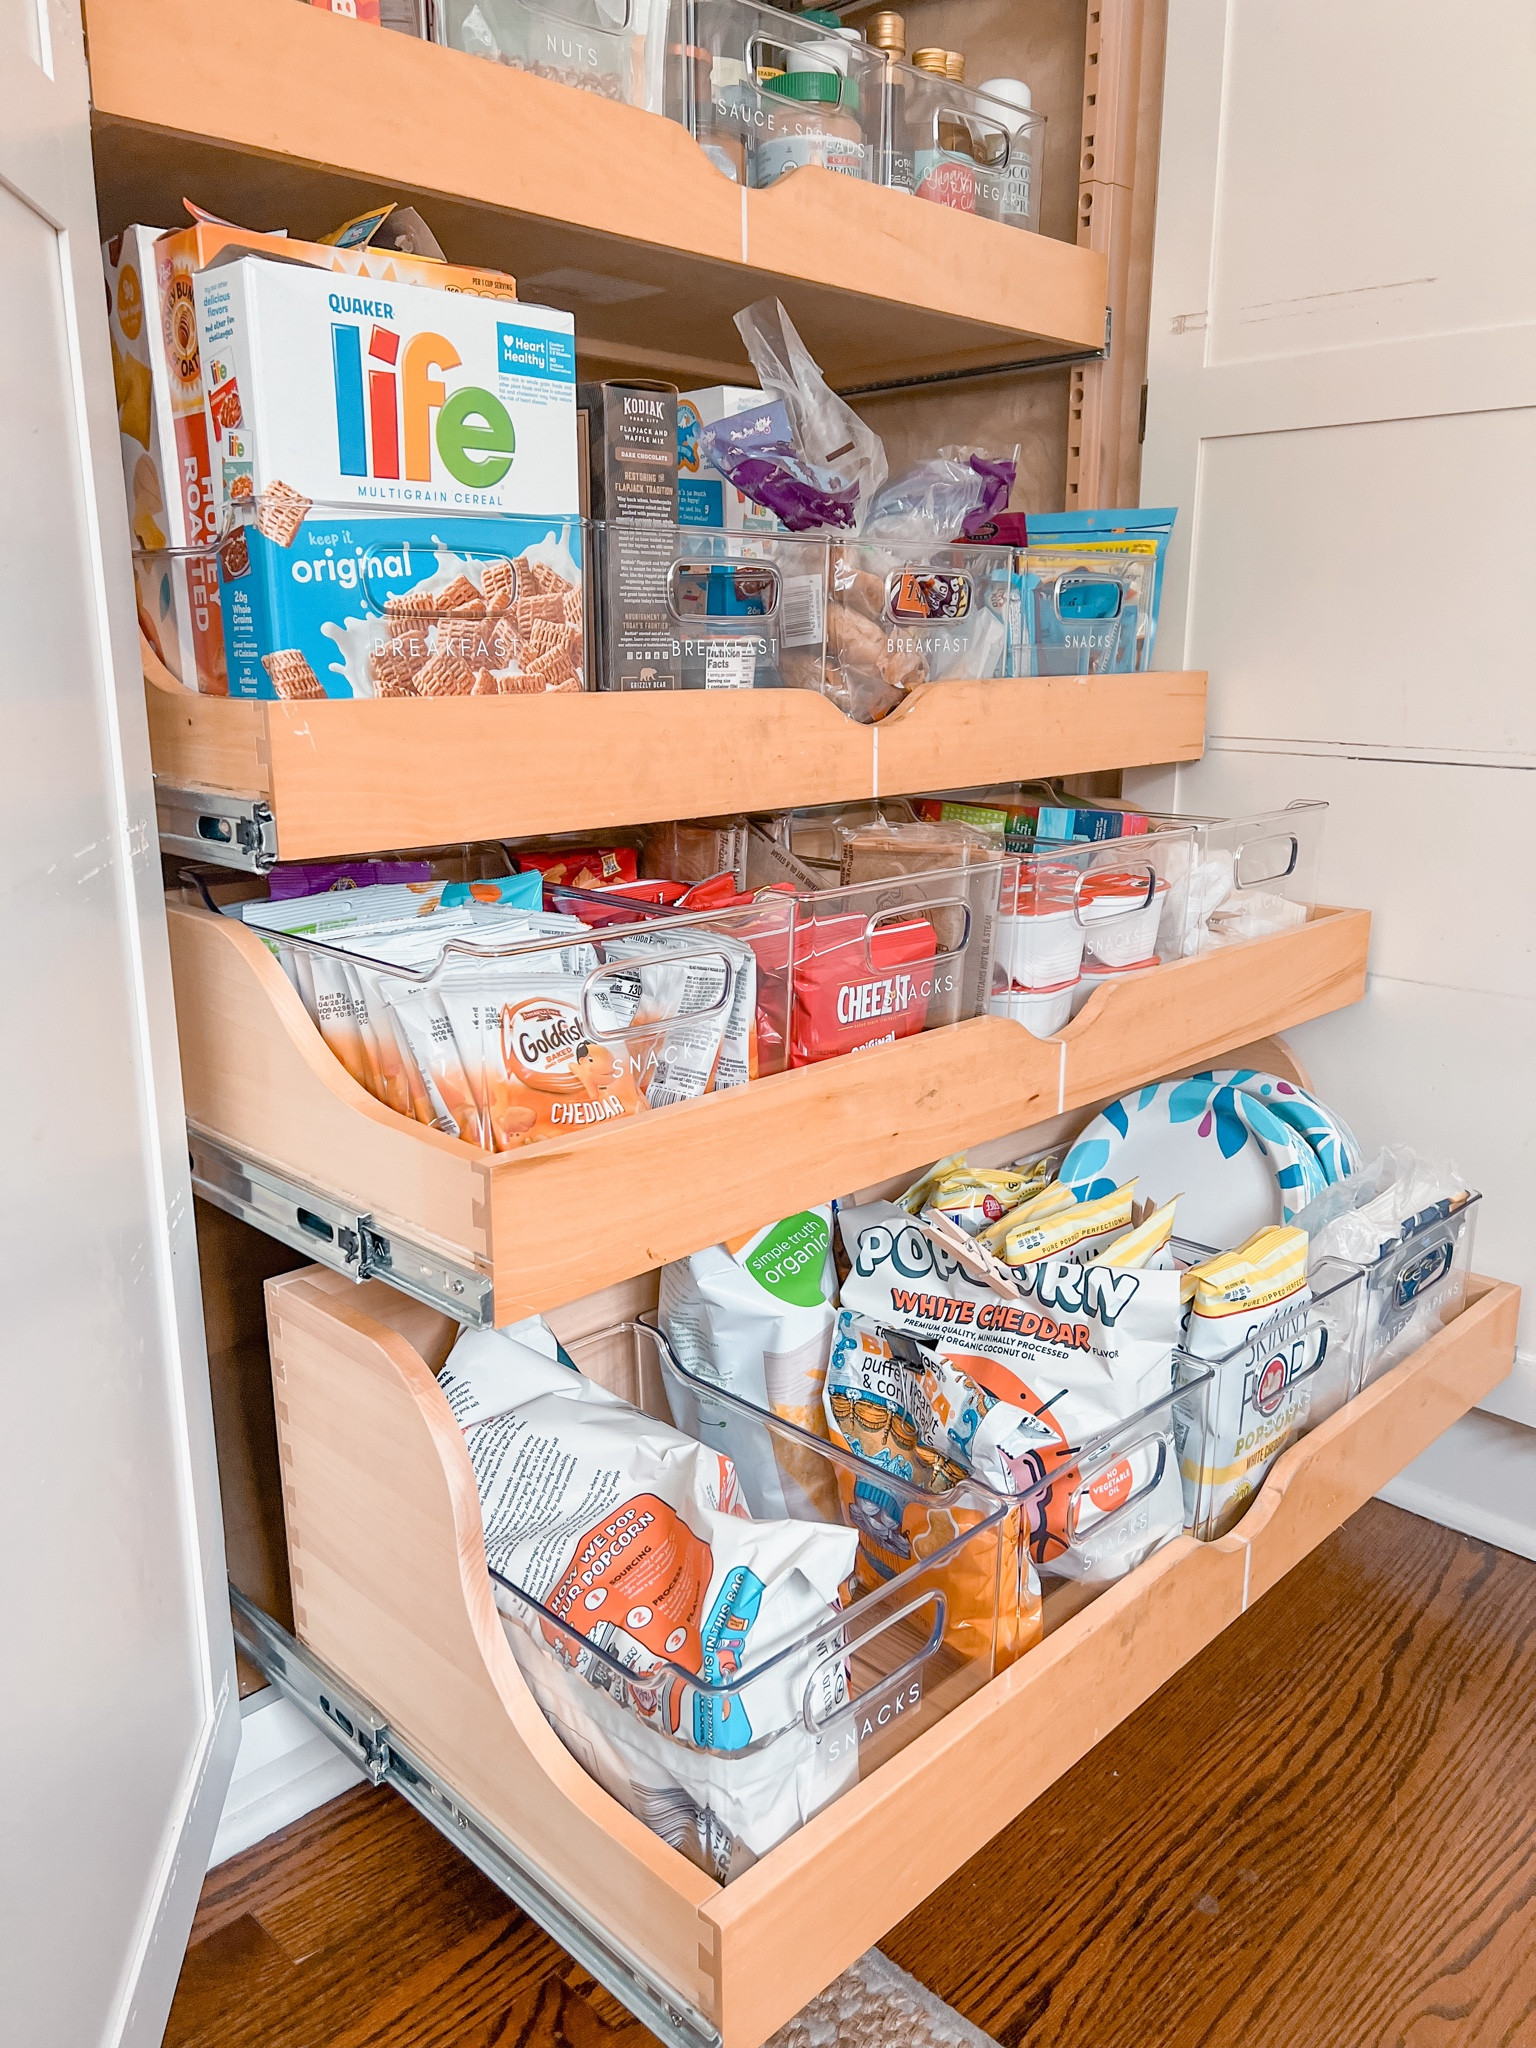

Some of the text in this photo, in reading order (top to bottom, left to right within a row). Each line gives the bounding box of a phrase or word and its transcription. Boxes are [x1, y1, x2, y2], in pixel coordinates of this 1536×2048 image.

[547, 33, 598, 66] NUTS
[718, 98, 775, 131] SAUCE
[795, 123, 865, 158] SPREADS
[204, 292, 230, 307] delicious
[328, 293, 394, 320] QUAKER
[207, 305, 229, 317] flavors
[516, 337, 545, 353] Heart
[504, 349, 545, 369] Healthy
[330, 322, 516, 489] life
[623, 397, 665, 420] KODIAK
[619, 425, 668, 437] FLAPJACK AND
[624, 434, 665, 445] WAFFLE MIX
[229, 434, 245, 457] life
[636, 452, 668, 462] CHOCOLATE
[624, 471, 657, 482] RESTORING
[358, 486, 503, 506] MULTIGRAIN CEREAL
[615, 482, 645, 493] FLAPJACK
[308, 530, 354, 547] keep it
[292, 541, 412, 589] original
[233, 590, 248, 603] 26g
[232, 605, 252, 614] Whole
[232, 614, 253, 625] Grains
[375, 638, 520, 657] BREAKFAST
[672, 639, 777, 657] BREAKFAST
[887, 638, 969, 653] BREAKFAST
[1064, 635, 1111, 648] SNACKS
[707, 659, 729, 669] Facts
[884, 975, 954, 1007] SNACKS
[545, 1047, 573, 1062] BAKED
[551, 1095, 626, 1124] CHEDDAR
[752, 1221, 820, 1270] simple truth
[1041, 1243, 1060, 1254] PURE
[765, 1232, 828, 1284] organic
[1243, 1298, 1260, 1309] PURE
[891, 1287, 1119, 1359] WHITE CHEDDAR FLAVOR
[903, 1317, 1070, 1360] PREMIUM QUALITY, MINIMALLY PROCESSED
[1373, 1317, 1411, 1353] PLATES
[926, 1332, 1036, 1362] WITH ORGANIC COCONUT OIL
[862, 1374, 872, 1390] &
[1238, 1340, 1305, 1436] POP
[539, 1440, 548, 1454] about
[504, 1477, 513, 1492] snacks
[512, 1449, 525, 1473] amazingly
[611, 1471, 620, 1487] people
[1106, 1468, 1118, 1479] NO
[1093, 1468, 1131, 1495] VEGETABLE
[1108, 1486, 1120, 1497] OIL
[580, 1510, 656, 1588] POPCORN
[1083, 1512, 1148, 1571] SNACKS
[551, 1508, 638, 1613] HOW WE POP
[608, 1545, 652, 1586] SOURCING
[706, 1572, 745, 1654] IN THIS BAG
[829, 1682, 920, 1762] SNACKS
